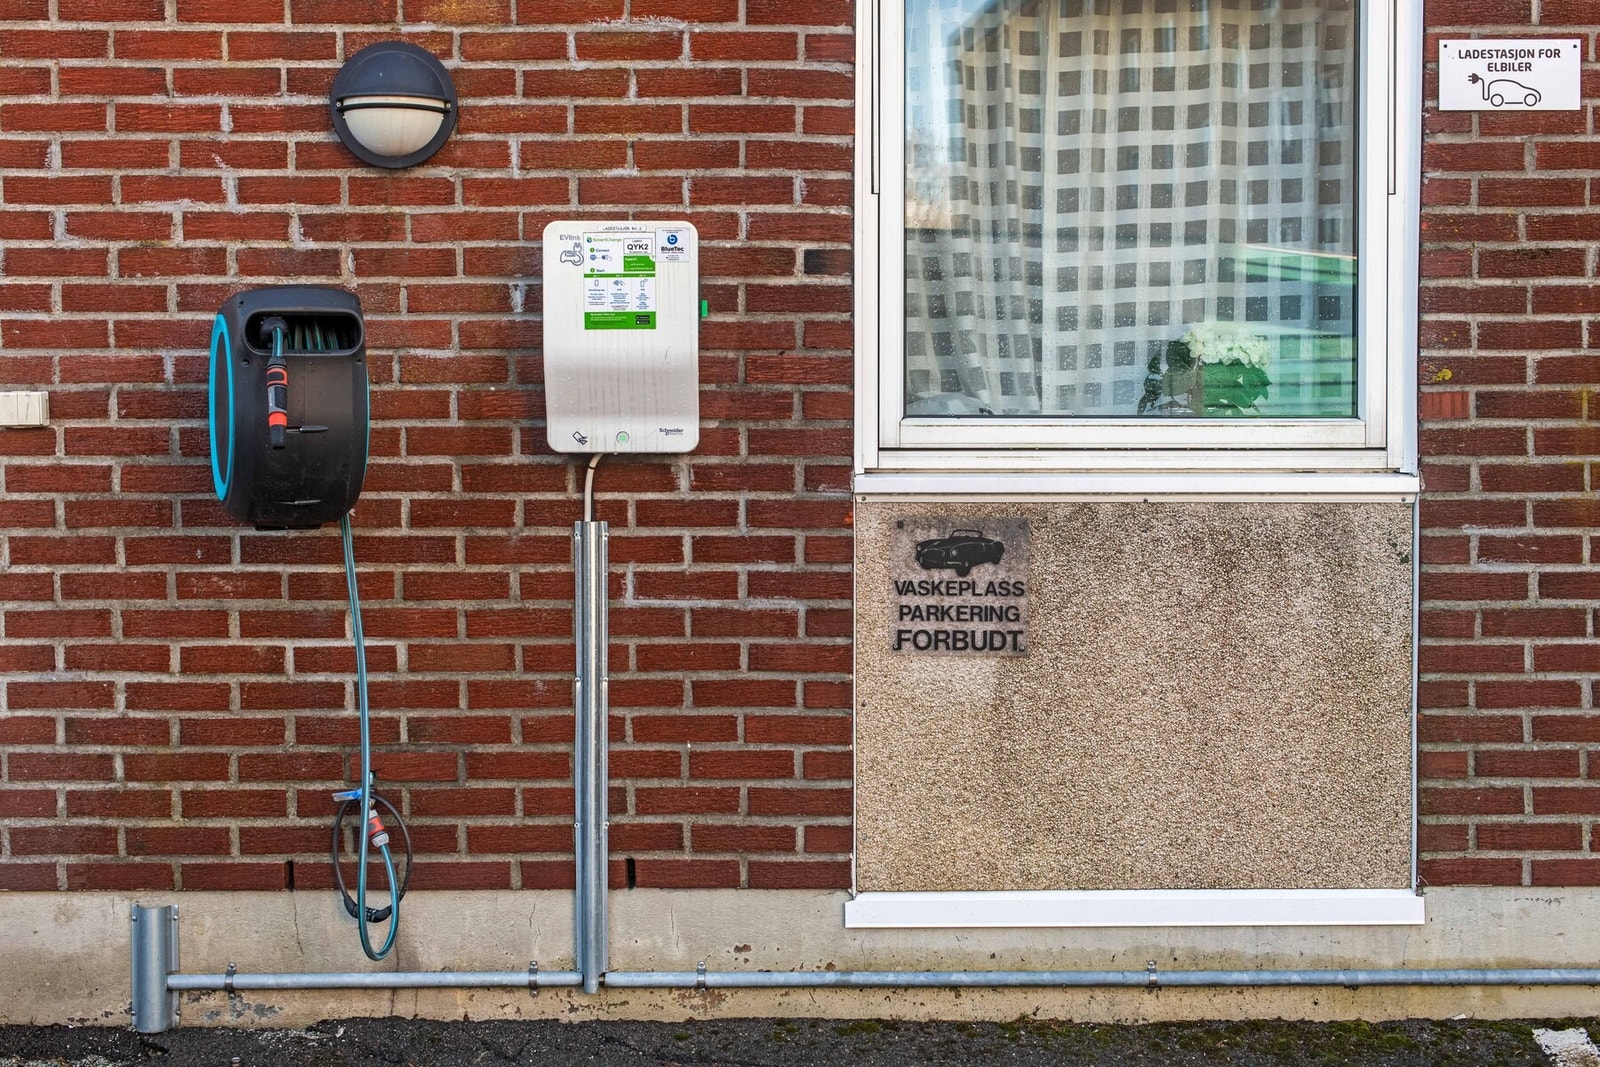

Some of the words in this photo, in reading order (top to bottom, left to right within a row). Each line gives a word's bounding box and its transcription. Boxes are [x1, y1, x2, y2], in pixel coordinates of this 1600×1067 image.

[1458, 48, 1535, 60] LADESTASJON
[1538, 48, 1561, 58] FOR
[1487, 62, 1532, 72] ELBILER
[627, 243, 649, 251] QYK2
[894, 580, 1025, 597] VASKEPLASS
[899, 605, 1020, 622] PARKERING
[895, 629, 1024, 652] FORBUDT
